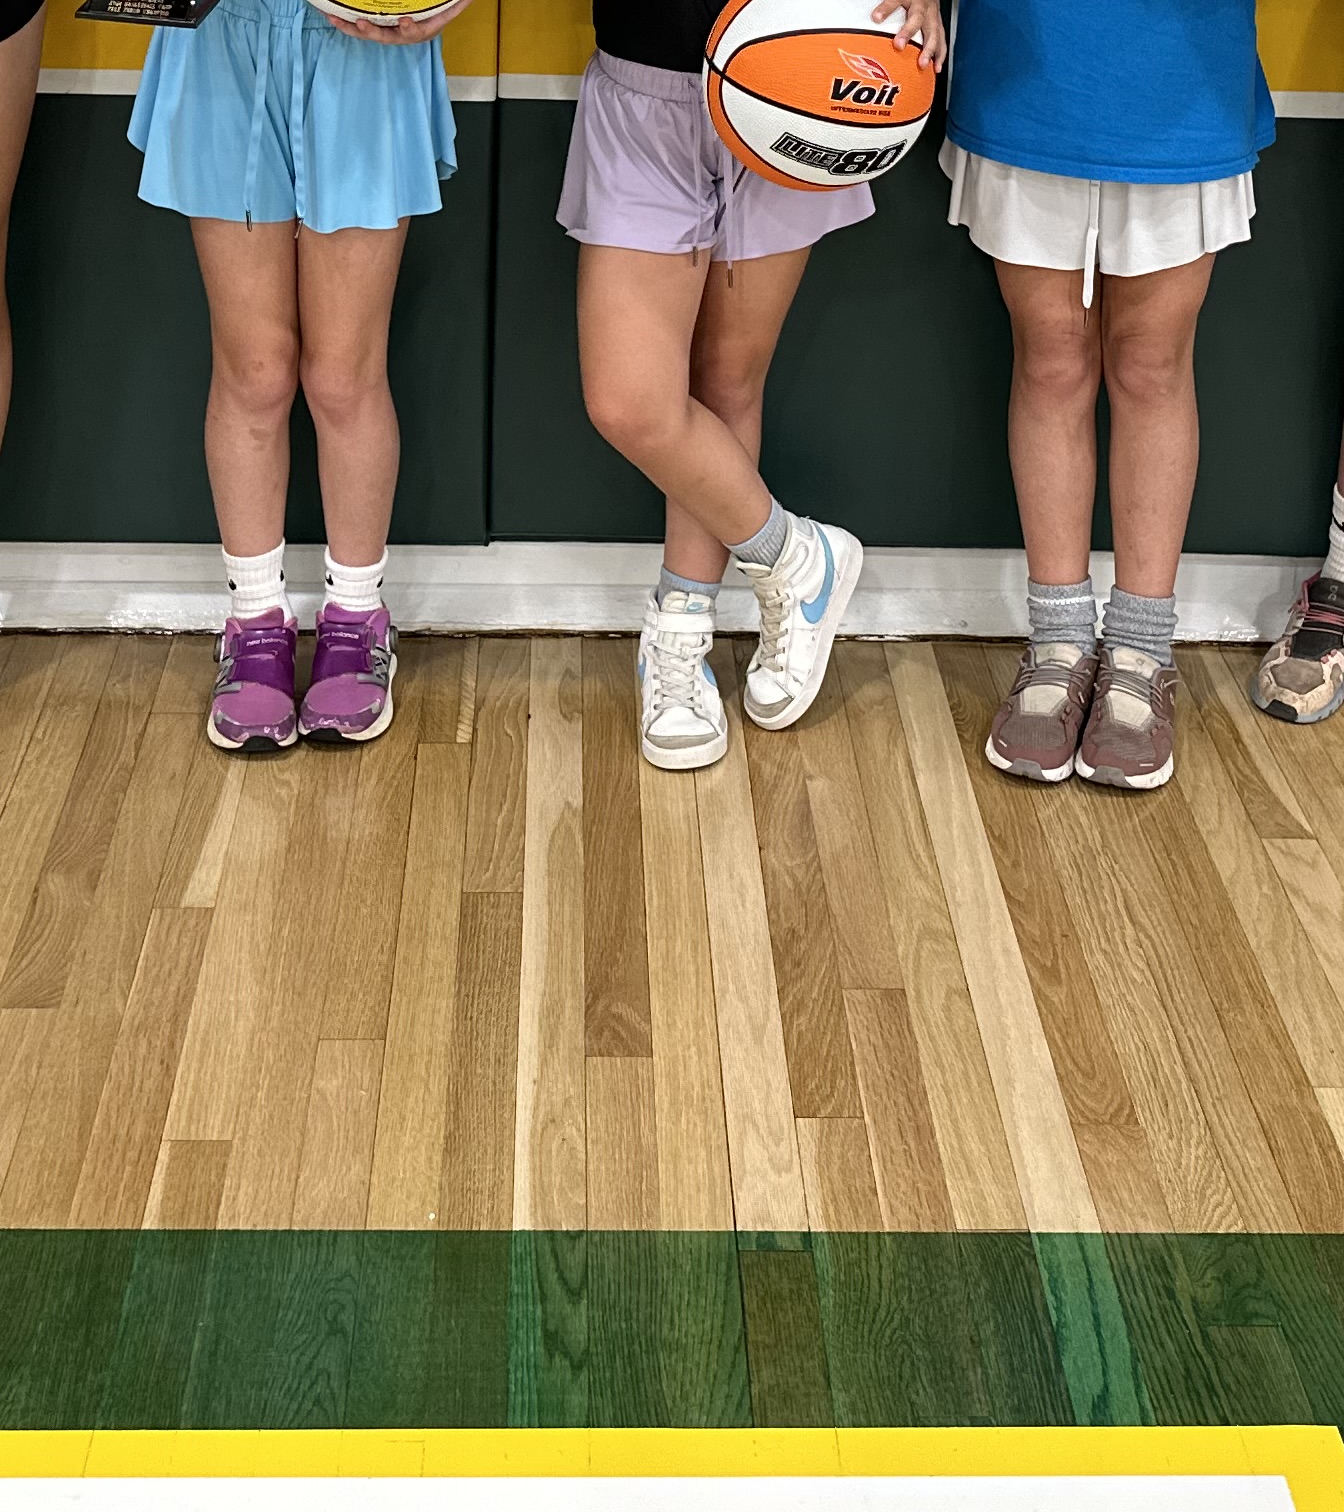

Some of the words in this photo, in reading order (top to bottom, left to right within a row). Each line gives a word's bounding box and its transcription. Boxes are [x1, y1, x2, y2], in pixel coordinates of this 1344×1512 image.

[830, 77, 901, 107] Voit
[780, 137, 839, 166] LITE
[831, 140, 907, 174] 80
